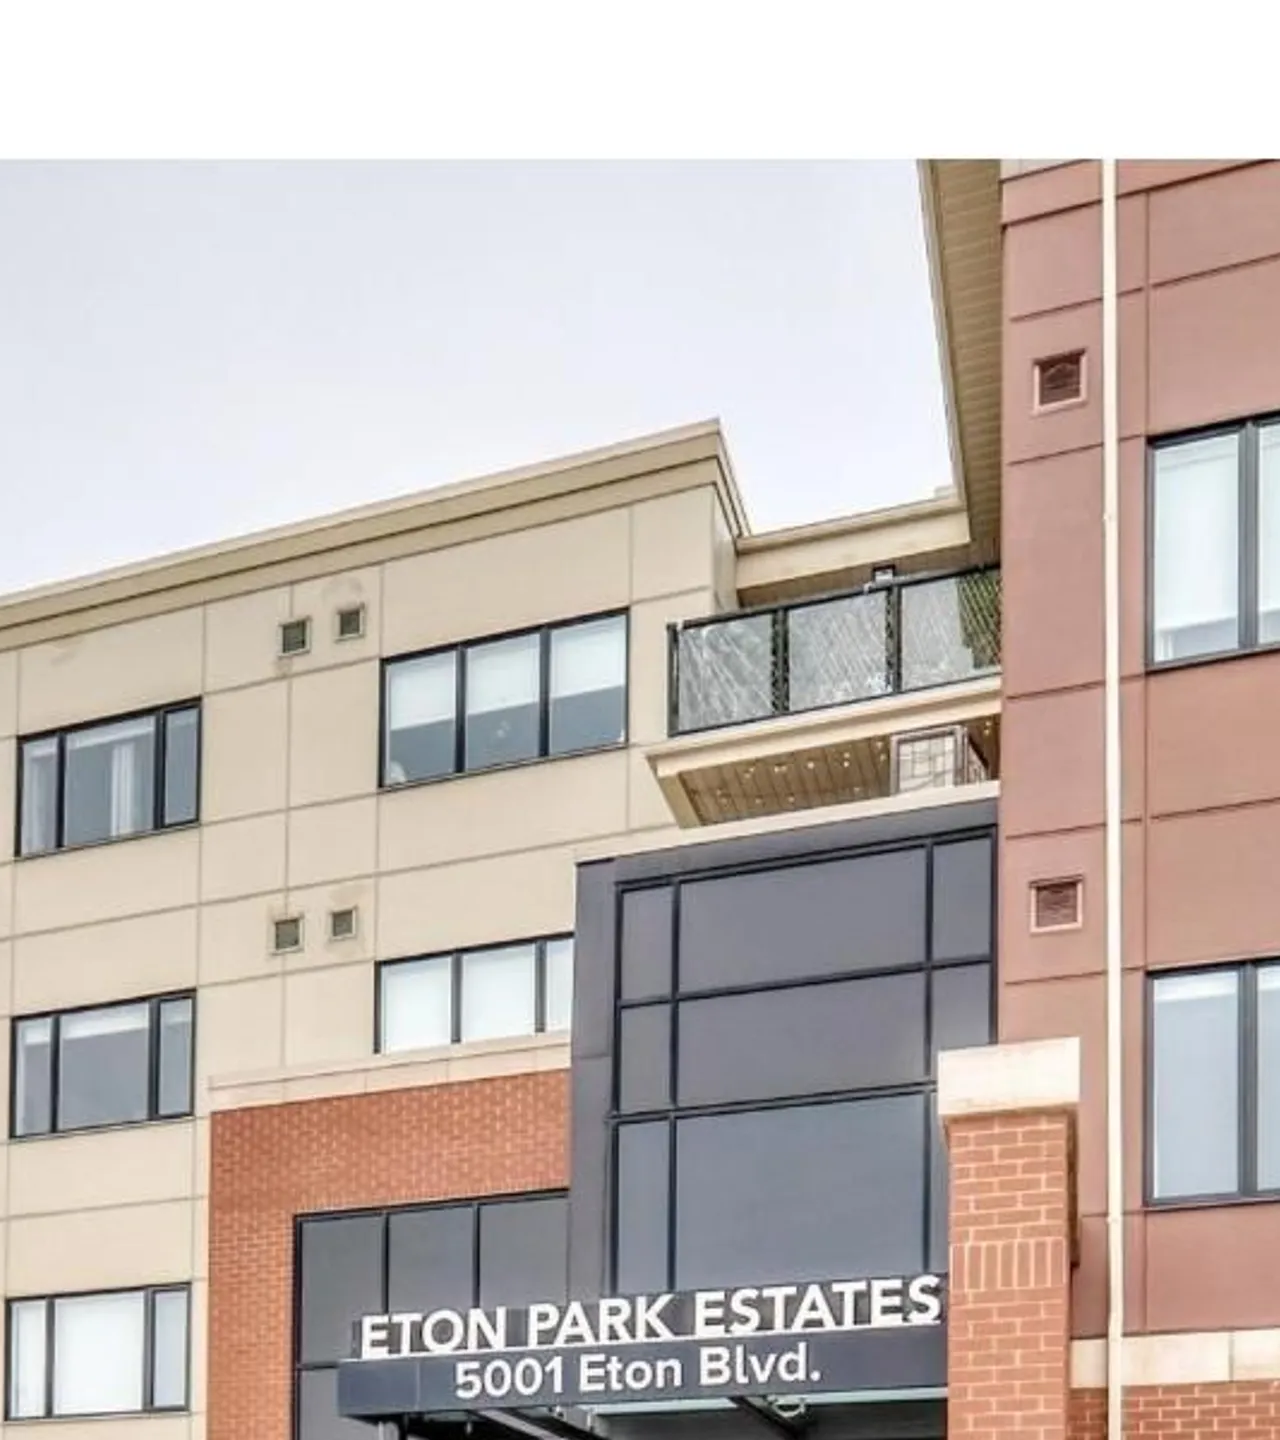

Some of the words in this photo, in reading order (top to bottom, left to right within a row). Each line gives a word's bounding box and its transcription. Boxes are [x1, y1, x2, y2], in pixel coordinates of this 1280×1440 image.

[361, 1307, 507, 1359] ETON
[529, 1294, 676, 1346] PARK
[695, 1275, 941, 1337] ESTATES
[455, 1356, 562, 1399] 5001
[579, 1352, 682, 1392] Eton
[700, 1343, 821, 1385] Blvd.
